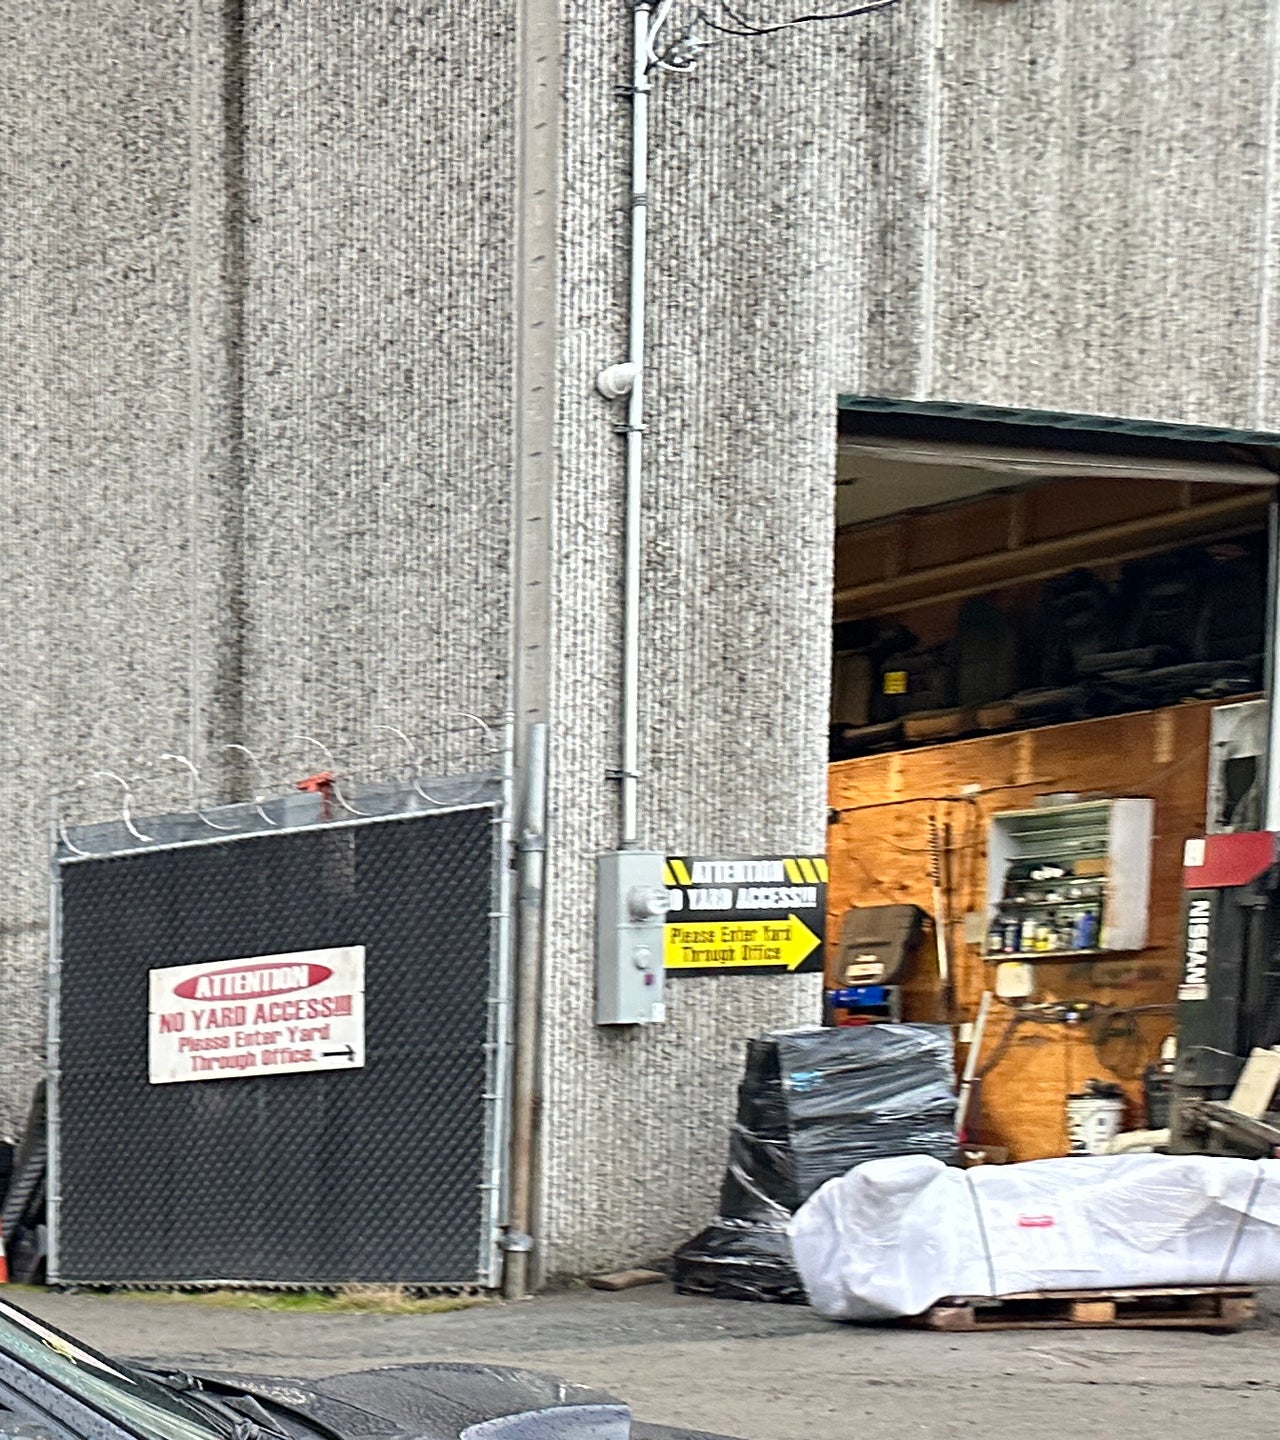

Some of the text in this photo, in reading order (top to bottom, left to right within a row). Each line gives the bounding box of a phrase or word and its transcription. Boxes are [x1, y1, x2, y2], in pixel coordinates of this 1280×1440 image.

[692, 860, 784, 883] ATTENTION
[687, 888, 733, 909] YARD
[670, 927, 715, 944] Please
[721, 926, 758, 943] Enter
[1183, 900, 1211, 984] NISSAN
[195, 965, 309, 998] ATTENTION
[159, 1012, 185, 1034] NO
[191, 1006, 246, 1030] YARD
[178, 1023, 330, 1052] Please Enter Yard
[190, 1051, 257, 1071] Through
